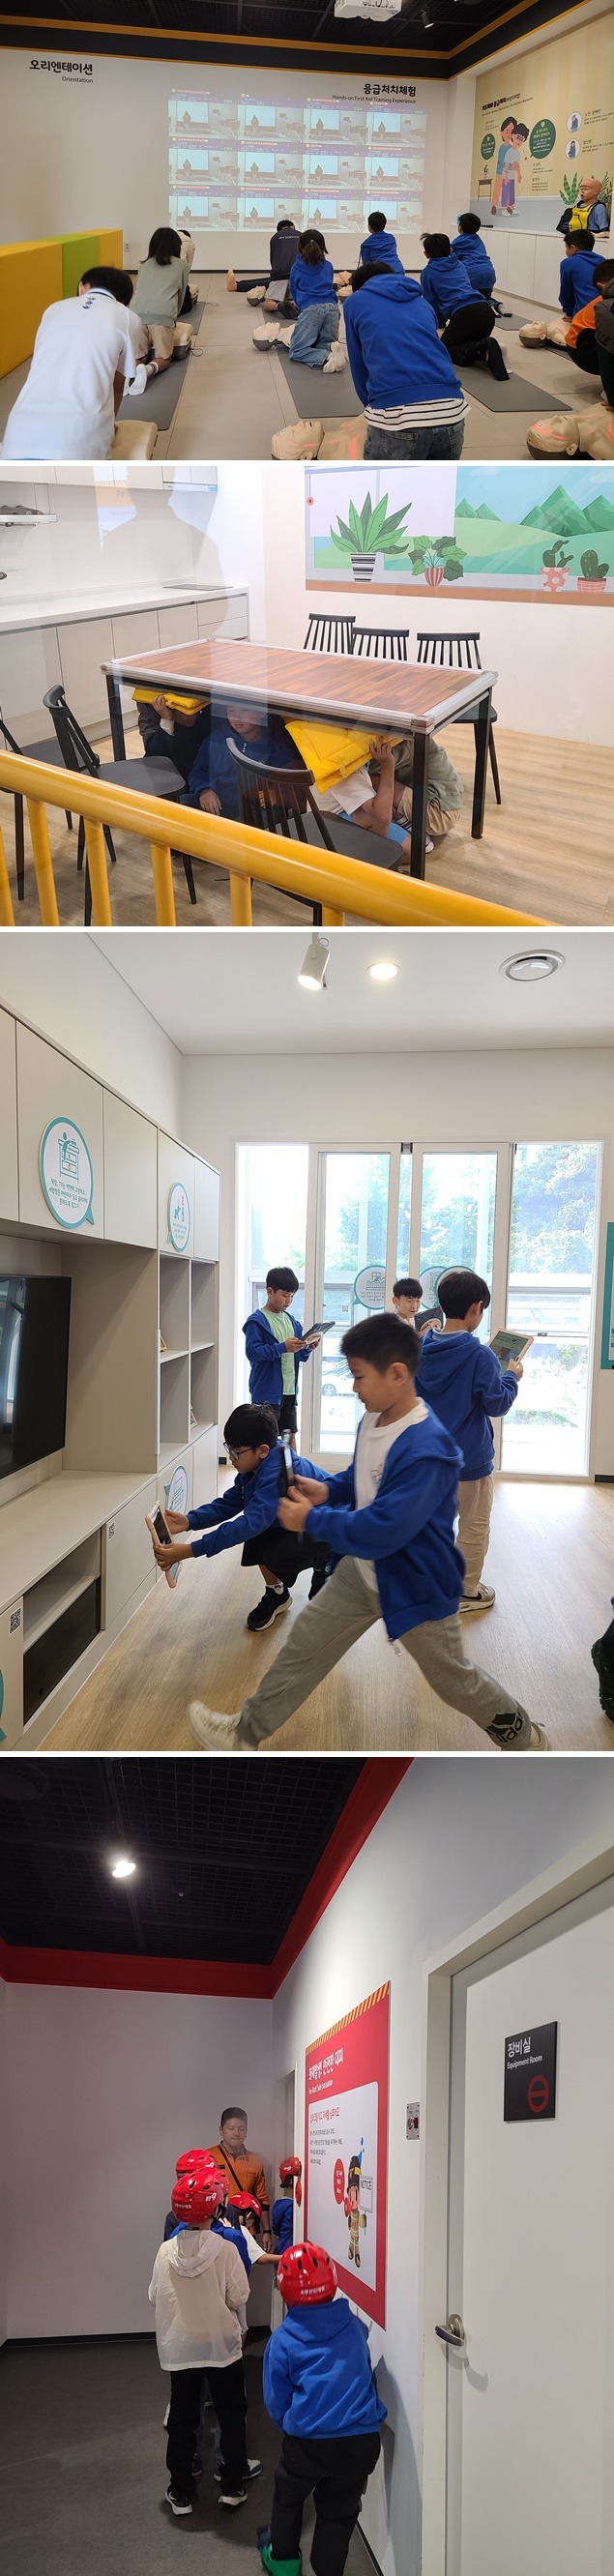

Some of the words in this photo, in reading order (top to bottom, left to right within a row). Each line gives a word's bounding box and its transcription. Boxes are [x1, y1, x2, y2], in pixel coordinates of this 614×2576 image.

[29, 60, 94, 75] 오리엔테이션
[61, 75, 94, 84] Orientation
[363, 83, 417, 98] 응급처치체험
[373, 96, 392, 104] Training
[392, 97, 417, 105] Experience
[508, 2036, 531, 2058] 장비실
[507, 2057, 529, 2070] Equipment
[530, 2055, 543, 2064] Room
